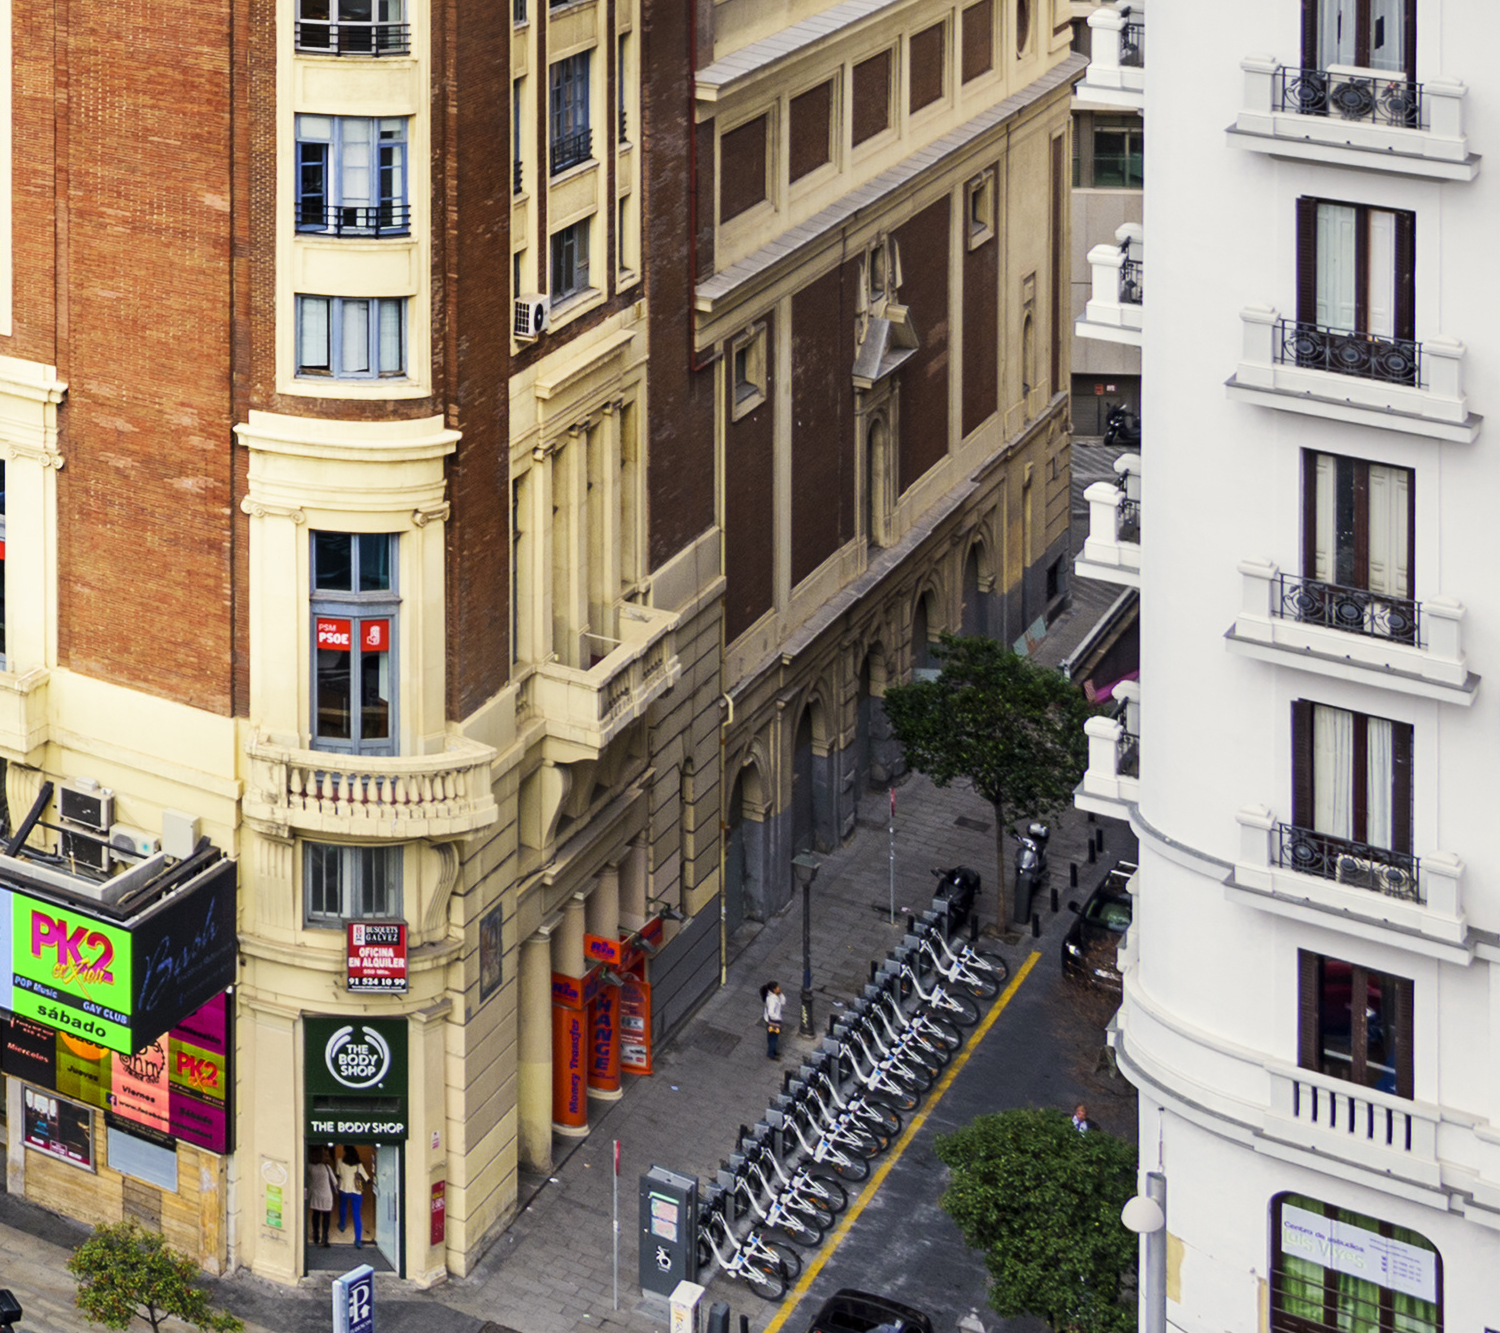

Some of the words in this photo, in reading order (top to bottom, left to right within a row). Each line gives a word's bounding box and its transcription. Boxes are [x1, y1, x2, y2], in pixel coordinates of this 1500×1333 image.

[365, 925, 399, 935] BUSQUETS
[365, 933, 398, 942] GALVEZ
[30, 908, 114, 985] PK2
[358, 946, 394, 958] OFICINA
[590, 941, 615, 957] Ria
[348, 956, 361, 968] EN
[361, 957, 405, 969] ALQUILER
[14, 976, 32, 989] POP
[33, 982, 58, 999] Music
[348, 977, 359, 986] 91
[381, 979, 392, 987] 10
[393, 979, 405, 987] 99
[37, 1003, 107, 1038] sábado
[82, 1000, 102, 1015] GAY
[102, 1008, 128, 1025] CLUB
[595, 997, 612, 1071] HANGE
[7, 1041, 50, 1064] Miercoles
[346, 1044, 369, 1055] THE
[569, 1018, 580, 1070] Transfer
[176, 1049, 219, 1087] PK2
[338, 1054, 378, 1066] BODY
[67, 1064, 99, 1083] Jueves
[340, 1065, 376, 1077] SHOP
[122, 1084, 156, 1104] Viernes
[569, 1074, 580, 1114] Money
[311, 1120, 335, 1133] THE
[337, 1121, 371, 1133] BODY
[372, 1122, 404, 1134] SHOP
